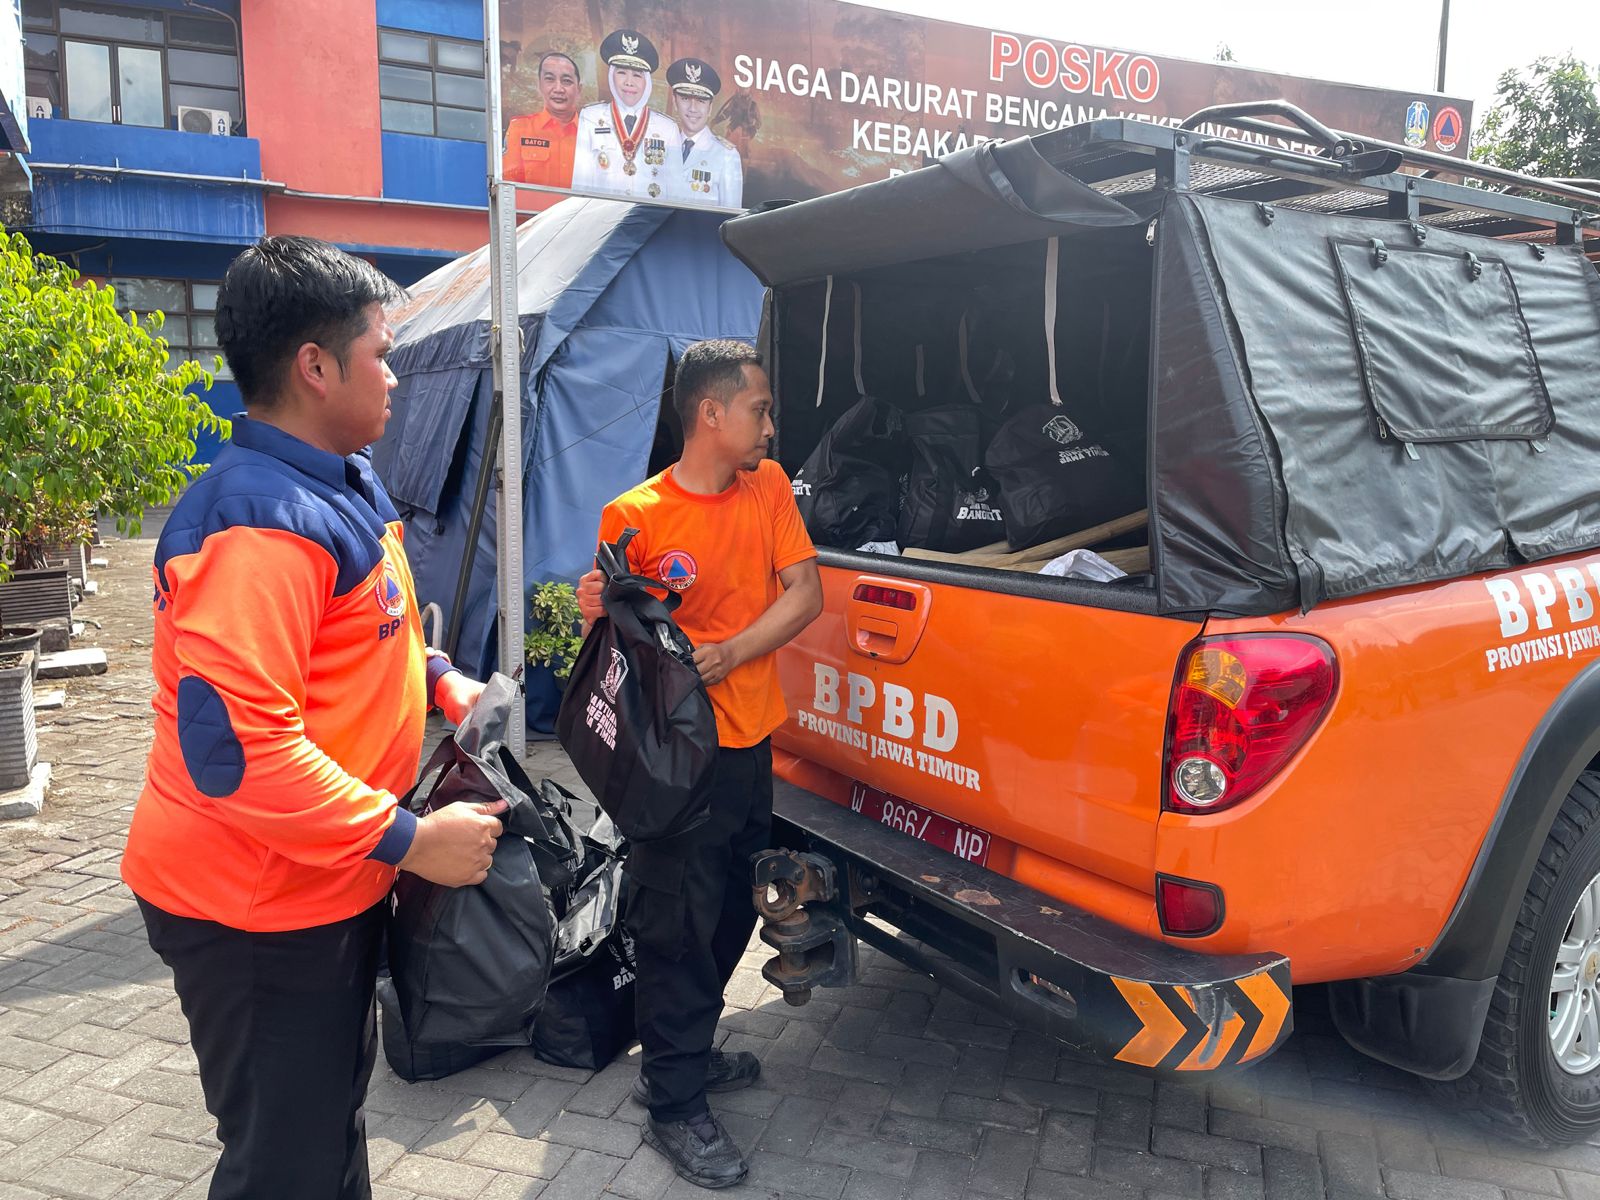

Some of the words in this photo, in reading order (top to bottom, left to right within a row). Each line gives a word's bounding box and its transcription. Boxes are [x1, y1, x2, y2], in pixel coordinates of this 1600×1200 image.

[733, 54, 832, 101] SIAGA
[840, 71, 978, 119] DARURAT
[989, 31, 1161, 103] POSKO
[1485, 633, 1565, 673] PROVINSI
[813, 662, 959, 753] BPBD
[797, 709, 868, 751] PROVINSI
[870, 735, 915, 768] JAWA
[916, 750, 981, 792] TIMUR
[851, 785, 866, 813] W
[953, 827, 984, 861] NP
